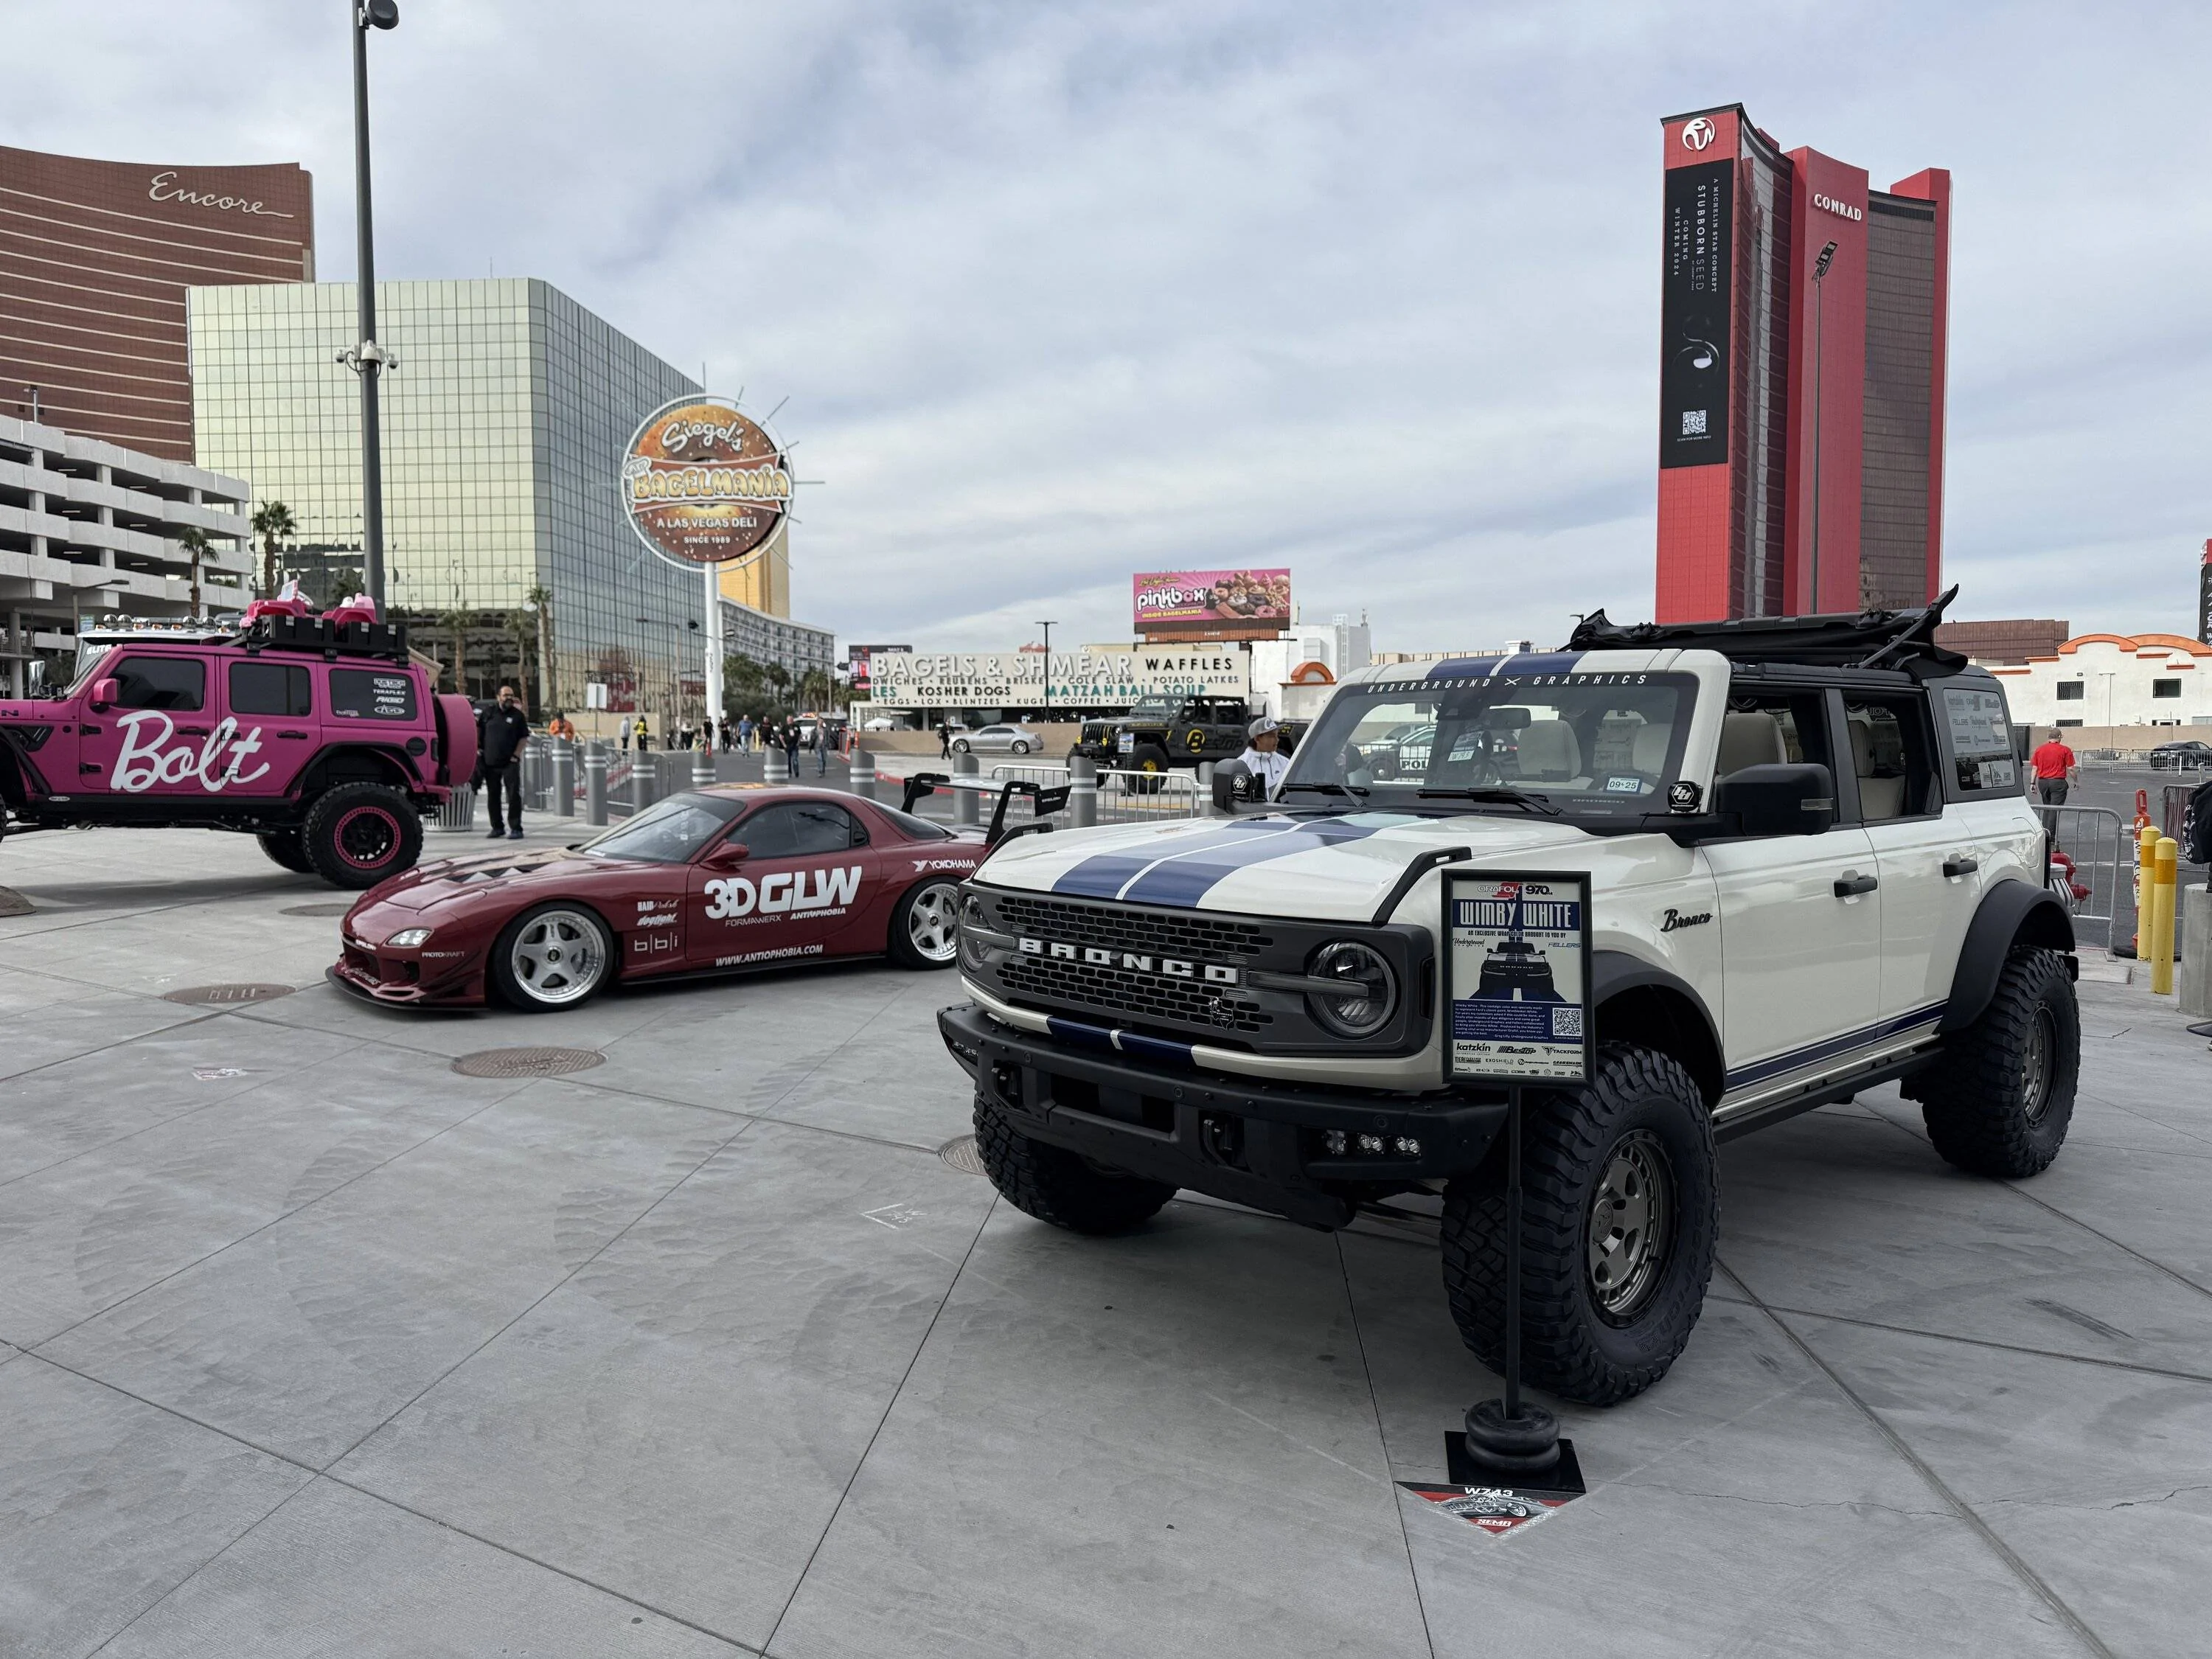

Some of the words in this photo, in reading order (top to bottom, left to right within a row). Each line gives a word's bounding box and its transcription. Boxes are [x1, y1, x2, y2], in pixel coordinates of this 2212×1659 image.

[149, 171, 294, 218] Encore
[1814, 193, 1862, 221] CONRAD
[1697, 185, 1705, 254] STUBBORN
[1696, 259, 1705, 290] SEED
[661, 420, 745, 453] Siegel's
[633, 467, 789, 499] BAGELMANIA
[657, 518, 665, 528] A
[667, 518, 687, 528] LAS
[691, 517, 728, 528] VEGAS
[731, 517, 757, 528] DELI
[1136, 587, 1206, 612] pinkbox
[1163, 609, 1202, 617] BAGELMANIA
[873, 655, 975, 677] BAGELS
[986, 655, 1004, 677] &
[1012, 655, 1132, 677] SHMEAR
[1145, 658, 1233, 671] WAFFLES
[939, 677, 987, 685] REUBENS
[1068, 676, 1096, 684] COLE
[1106, 676, 1134, 684] SLAW
[1152, 675, 1194, 684] POTATO
[1200, 675, 1239, 684] LATKES
[1368, 678, 1490, 695] UNDERGROUND
[1534, 675, 1646, 685] GRAPHICS
[917, 686, 968, 696] KOSHER
[975, 686, 1011, 696] DOGS
[1044, 685, 1113, 697] MATZAH
[1163, 685, 1206, 696] SOUP
[111, 709, 270, 793] Bolt
[928, 859, 976, 869] YOKOHAMA
[1478, 885, 1519, 893] ORAFOL
[725, 914, 782, 928] FORMAWERX
[1460, 902, 1517, 926] WIMBY
[1523, 902, 1571, 928] WHITE
[1660, 908, 1713, 932] Bronco
[1452, 938, 1485, 947] Underground
[715, 944, 823, 967] WWW.ANTIOPHOBIA.COM
[1019, 937, 1239, 984] BRONCO
[1456, 1042, 1491, 1052] katzkin
[1464, 1486, 1513, 1497] W743
